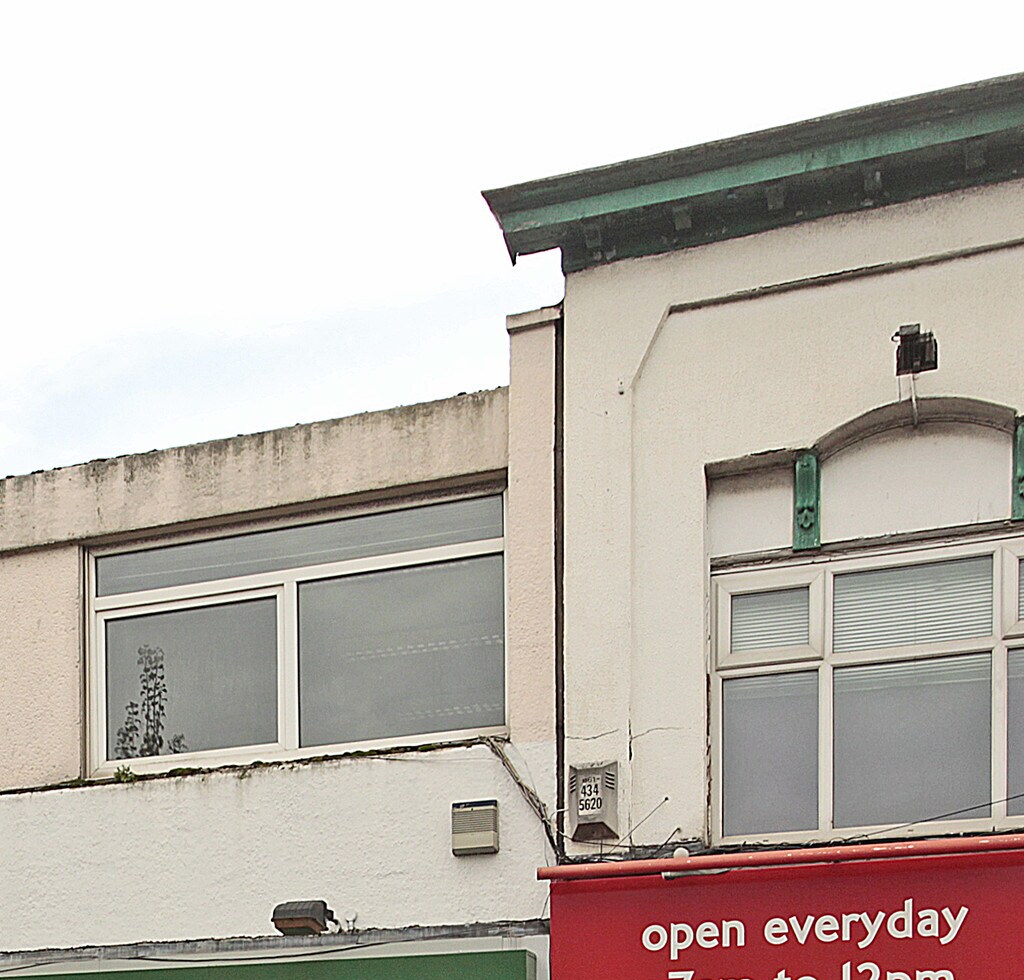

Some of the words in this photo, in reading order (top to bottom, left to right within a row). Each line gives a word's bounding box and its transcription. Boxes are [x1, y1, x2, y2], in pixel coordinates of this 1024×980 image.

[580, 784, 599, 797] 434
[579, 797, 602, 810] 5620
[641, 919, 746, 960] open
[764, 898, 969, 949] everyday
